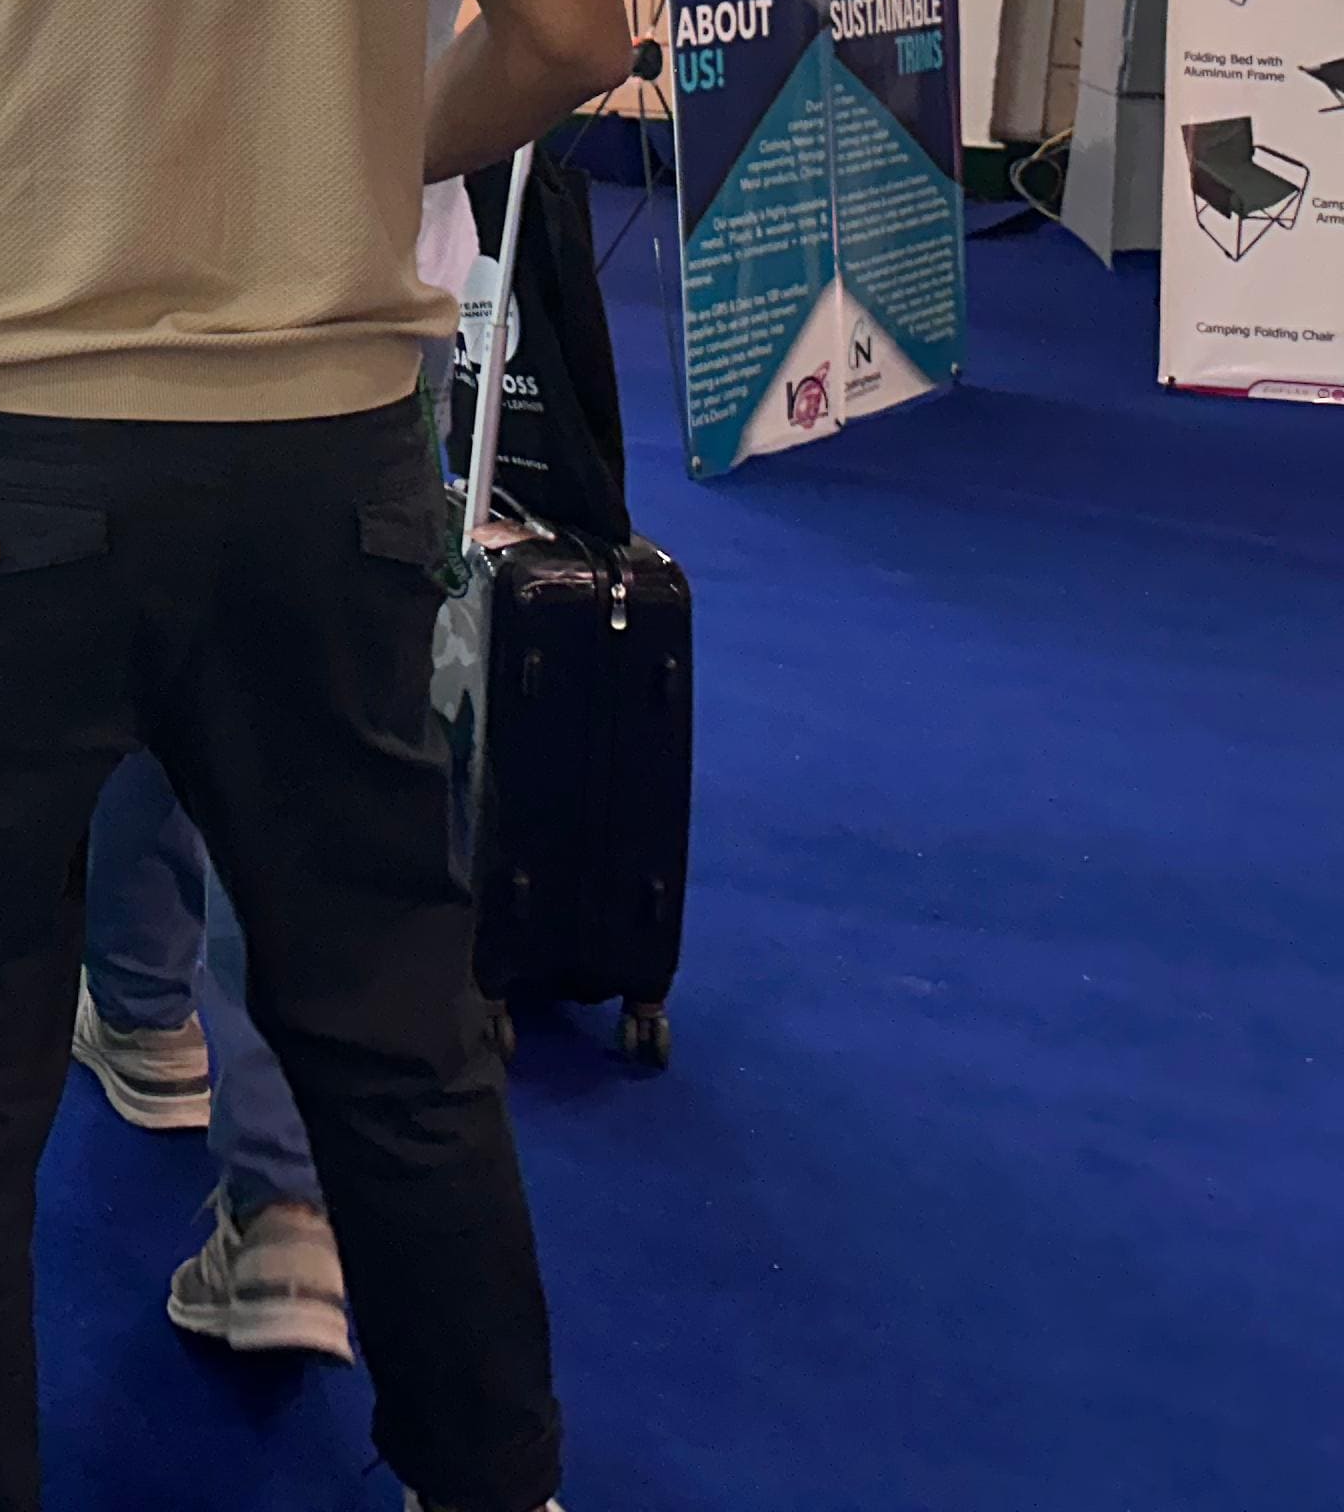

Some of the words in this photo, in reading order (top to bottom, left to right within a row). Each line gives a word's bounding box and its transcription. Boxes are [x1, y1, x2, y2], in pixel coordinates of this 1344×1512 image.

[895, 29, 943, 76] TRIMS
[1184, 51, 1226, 66] Folding
[1230, 54, 1253, 66] Bed
[1257, 56, 1283, 67] with
[679, 49, 724, 93] US!
[1184, 65, 1243, 80] Aluminum
[1247, 70, 1285, 82] Frame
[1196, 321, 1250, 338] Camping
[1254, 326, 1298, 342] Folding
[1302, 329, 1335, 341] Chair
